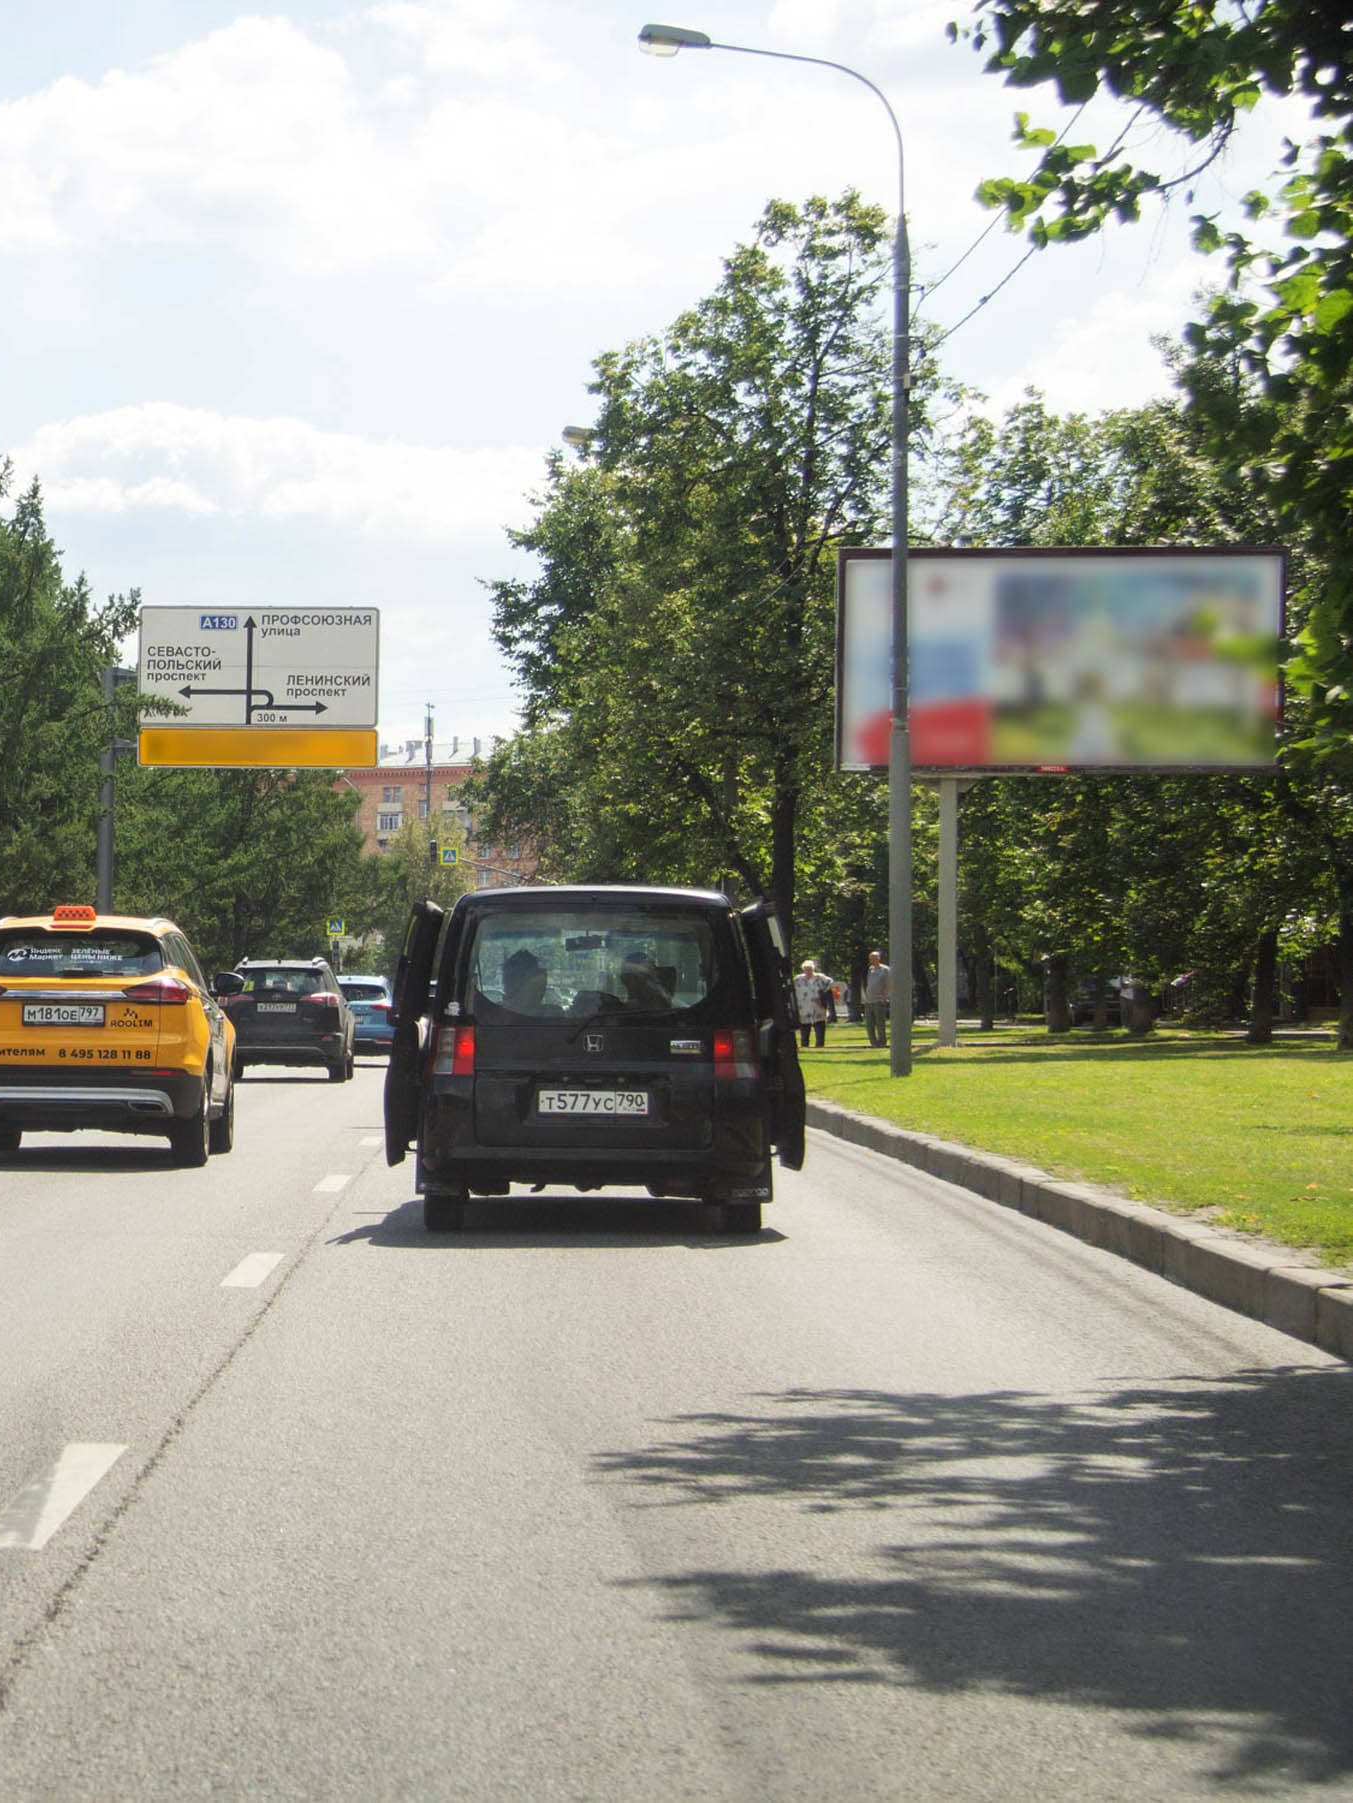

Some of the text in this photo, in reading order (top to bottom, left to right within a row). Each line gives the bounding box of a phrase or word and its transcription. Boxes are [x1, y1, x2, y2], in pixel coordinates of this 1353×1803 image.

[261, 614, 372, 626] ПРОФСОЮЗНАЯ
[261, 627, 301, 638] улица
[147, 646, 216, 657] СЕВАСТО-
[147, 656, 222, 671] ПОЛЬСКИЙ
[147, 672, 206, 682] проспект
[286, 673, 371, 687] ЛЕНИНСКИЙ
[286, 687, 347, 698] проспект
[257, 713, 276, 722] 300
[80, 1007, 99, 1017] 797
[58, 1048, 67, 1059] 8
[70, 1049, 94, 1060] 495
[98, 1049, 117, 1060] 128
[121, 1050, 131, 1060] 11
[135, 1050, 151, 1060] 88
[616, 1093, 644, 1107] 790
